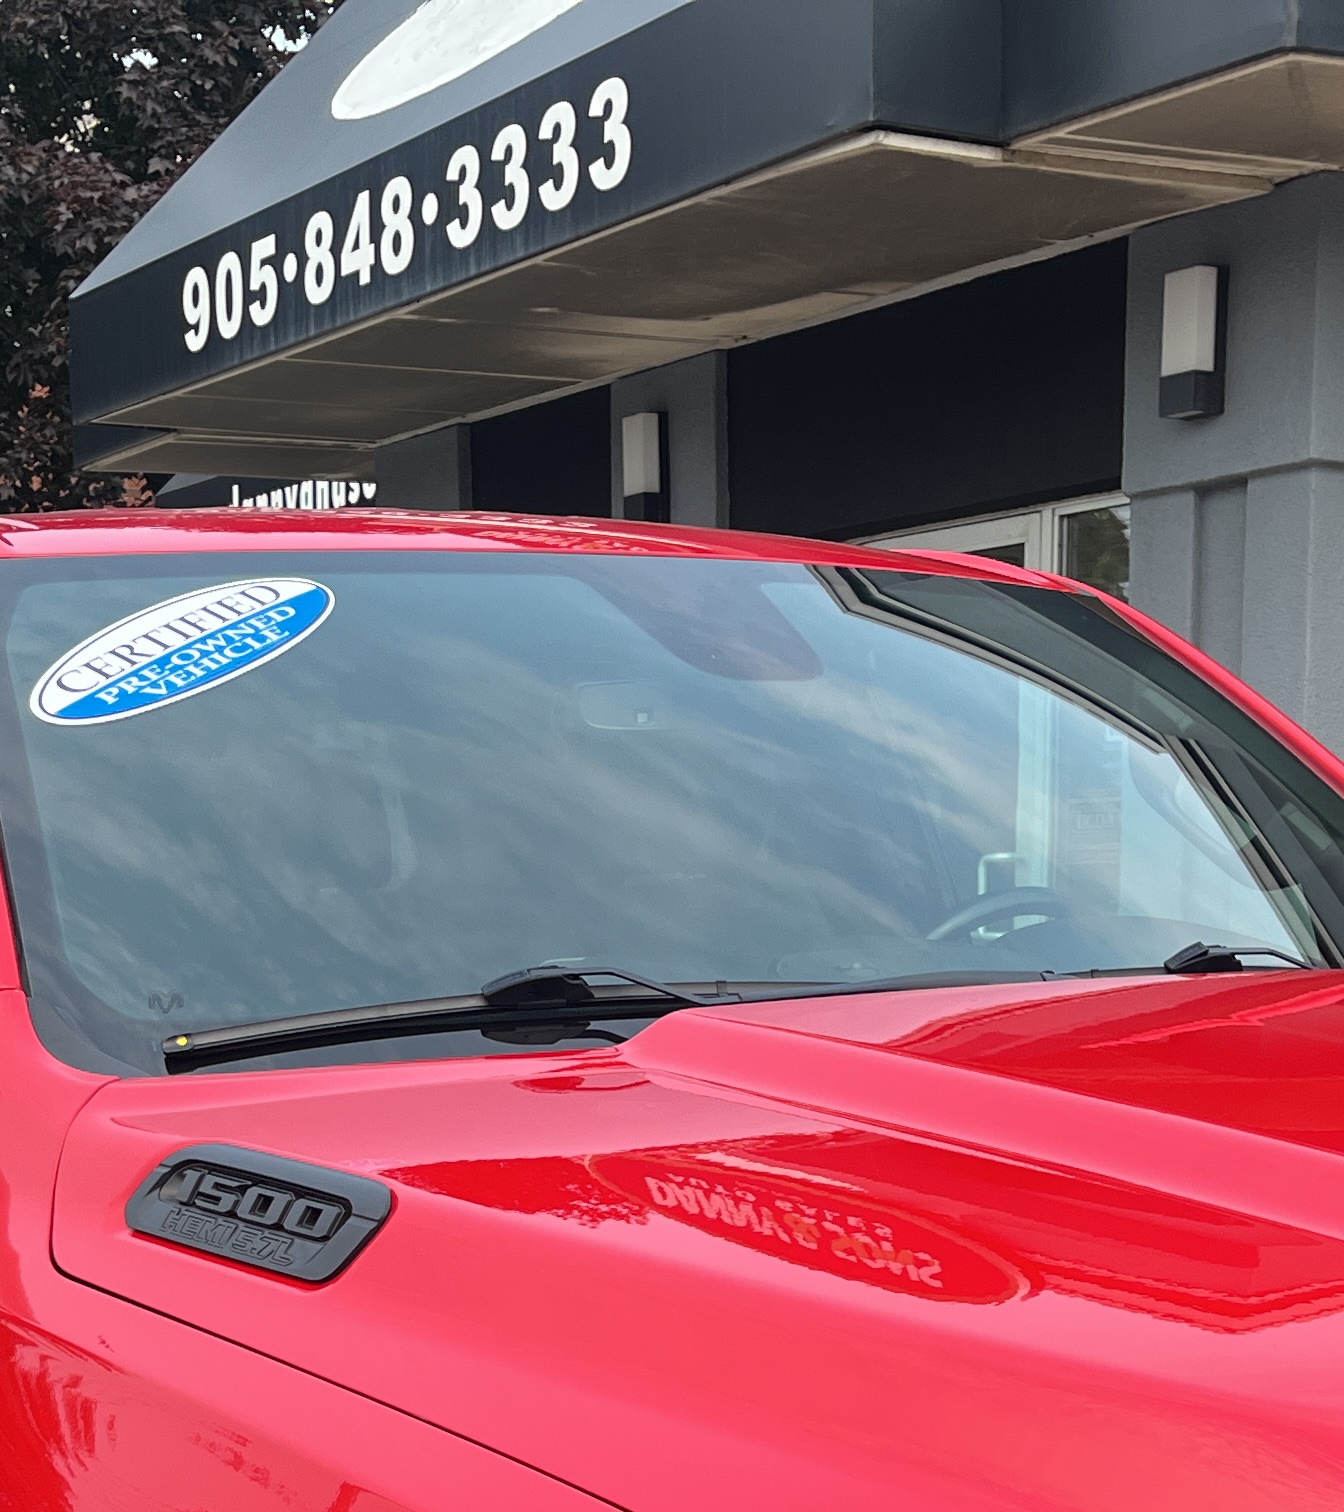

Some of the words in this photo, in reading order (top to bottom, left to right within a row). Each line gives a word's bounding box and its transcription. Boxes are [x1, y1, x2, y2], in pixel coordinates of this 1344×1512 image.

[56, 585, 281, 693] CERTIFIED
[94, 606, 297, 705] PRE-OWNED
[140, 626, 291, 697] VEHICLE
[174, 1165, 346, 1240] 1500
